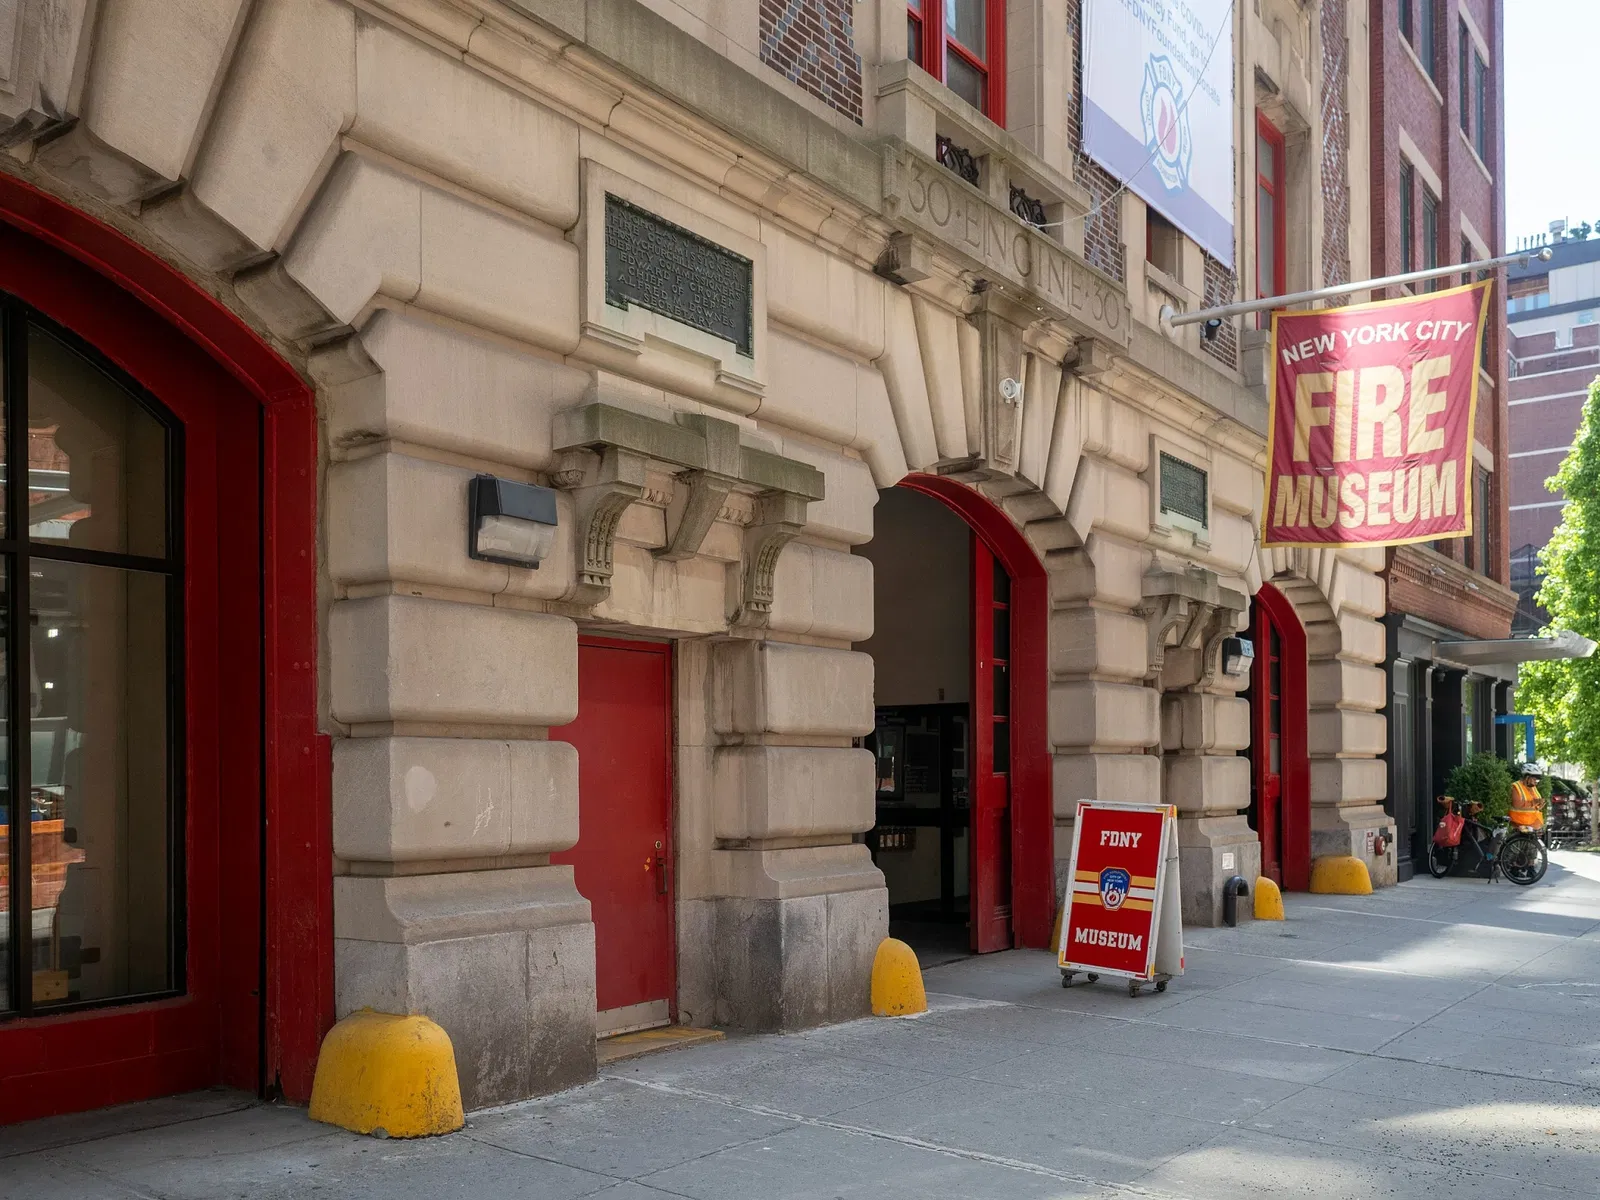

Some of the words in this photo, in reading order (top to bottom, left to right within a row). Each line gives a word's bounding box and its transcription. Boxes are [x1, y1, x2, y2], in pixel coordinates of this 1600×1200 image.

[611, 214, 640, 237] FIRE
[608, 235, 653, 264] DEPUTY
[907, 162, 951, 227] 30
[1092, 278, 1120, 331] 30
[619, 250, 671, 282] EDWARD
[627, 264, 664, 289] CHIEF
[671, 282, 684, 297] OF
[616, 270, 668, 302] ALFRED
[643, 291, 713, 329] SECRETARY
[1281, 332, 1337, 366] NEW
[1341, 321, 1410, 348] YORK
[1415, 319, 1472, 342] CITY
[1292, 355, 1452, 463] FIRE
[1273, 459, 1458, 529] MUSEUM
[1099, 830, 1143, 848] FDNY
[1074, 927, 1143, 951] MUSEUM
